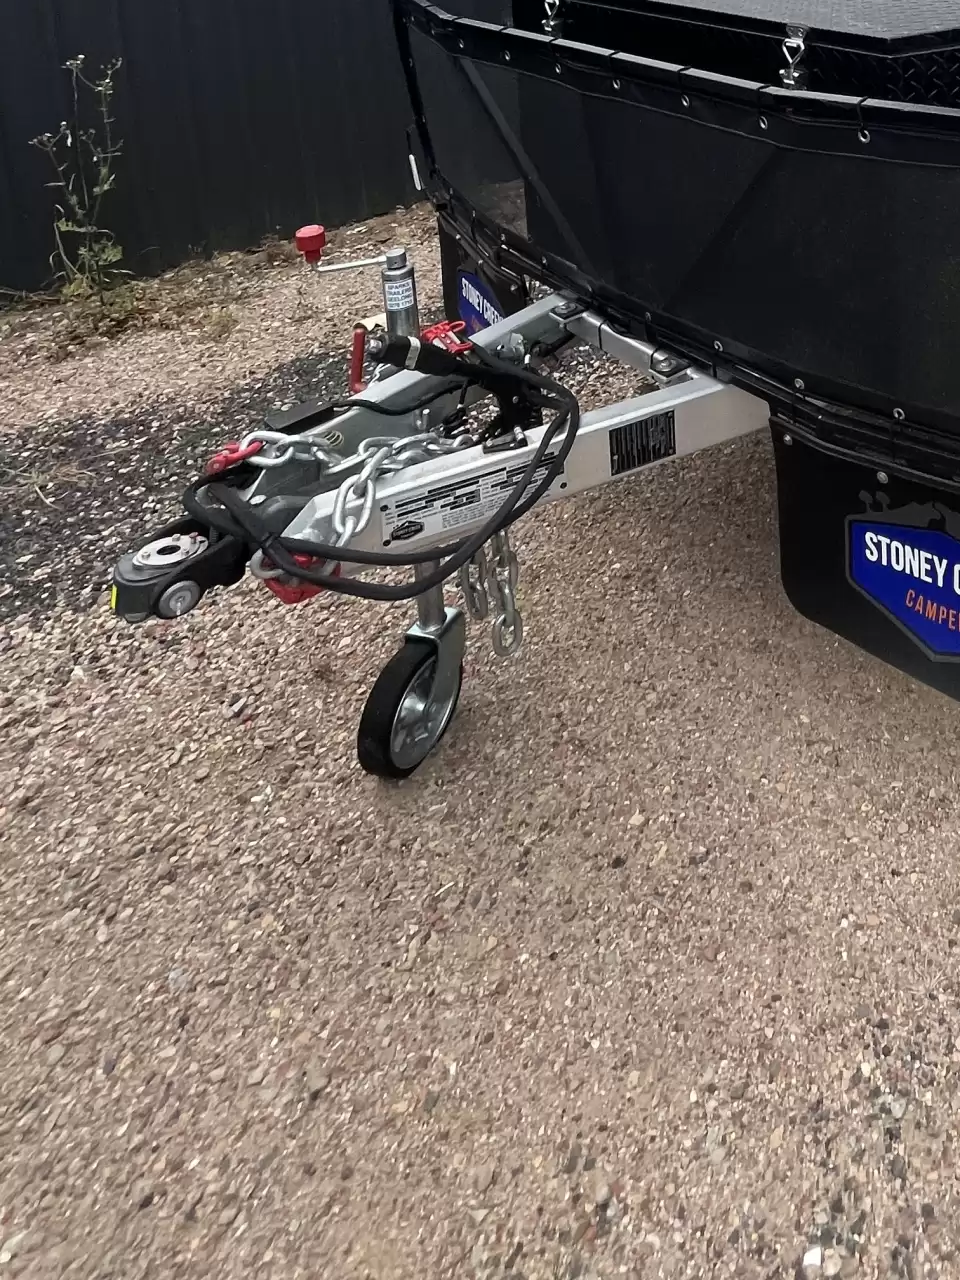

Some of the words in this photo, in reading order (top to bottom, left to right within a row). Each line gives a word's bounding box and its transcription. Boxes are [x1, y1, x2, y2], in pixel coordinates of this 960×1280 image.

[462, 277, 483, 314] STONEY
[483, 298, 504, 325] CREE
[865, 531, 948, 587] STONEY
